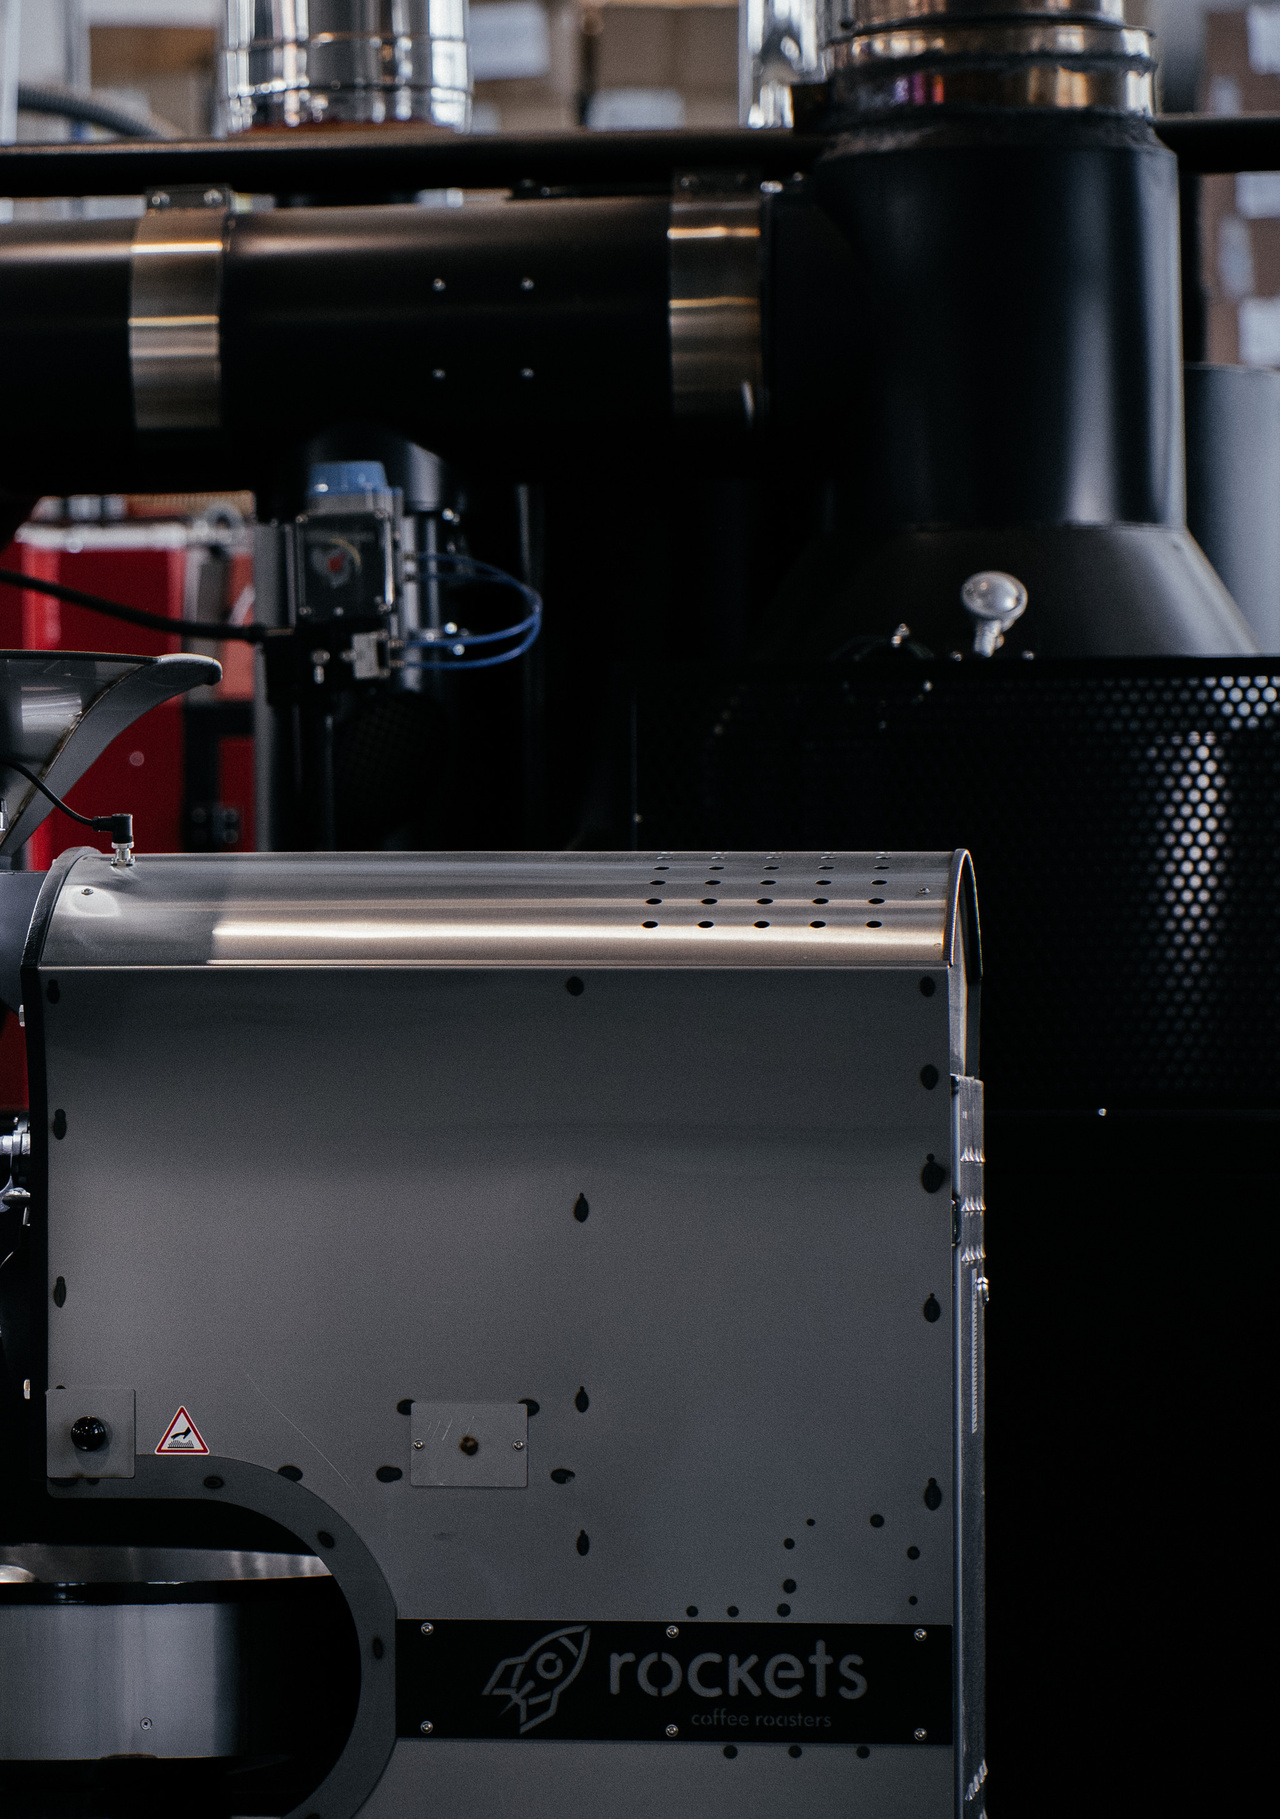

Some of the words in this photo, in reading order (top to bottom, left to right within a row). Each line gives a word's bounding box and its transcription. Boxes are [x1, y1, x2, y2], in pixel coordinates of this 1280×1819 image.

[609, 1639, 868, 1700] rockets
[691, 1707, 751, 1727] coffee
[756, 1711, 832, 1729] roasters
